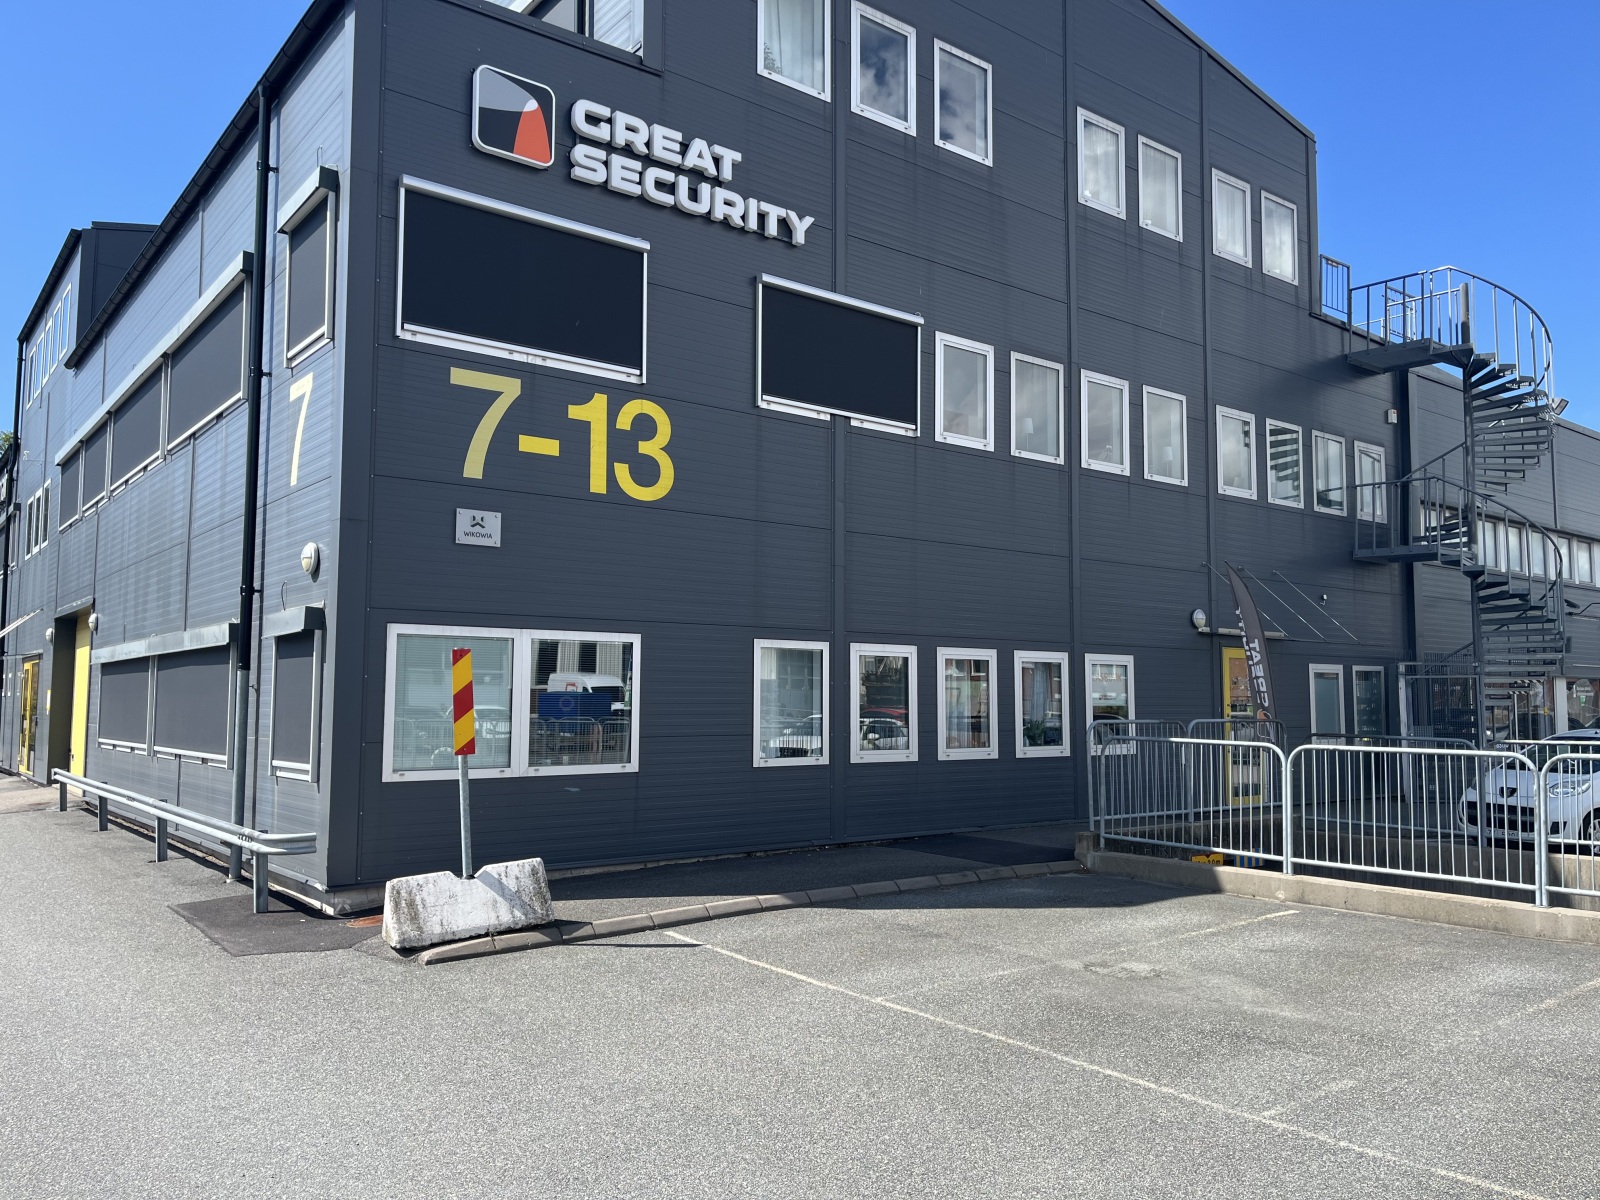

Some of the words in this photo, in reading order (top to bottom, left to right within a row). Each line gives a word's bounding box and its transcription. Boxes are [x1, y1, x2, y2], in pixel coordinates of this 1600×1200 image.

[571, 99, 742, 182] GREAT
[570, 143, 815, 247] SECURITY
[289, 372, 313, 487] 7
[450, 367, 674, 501] 7-13
[463, 530, 493, 539] WIKOWIA
